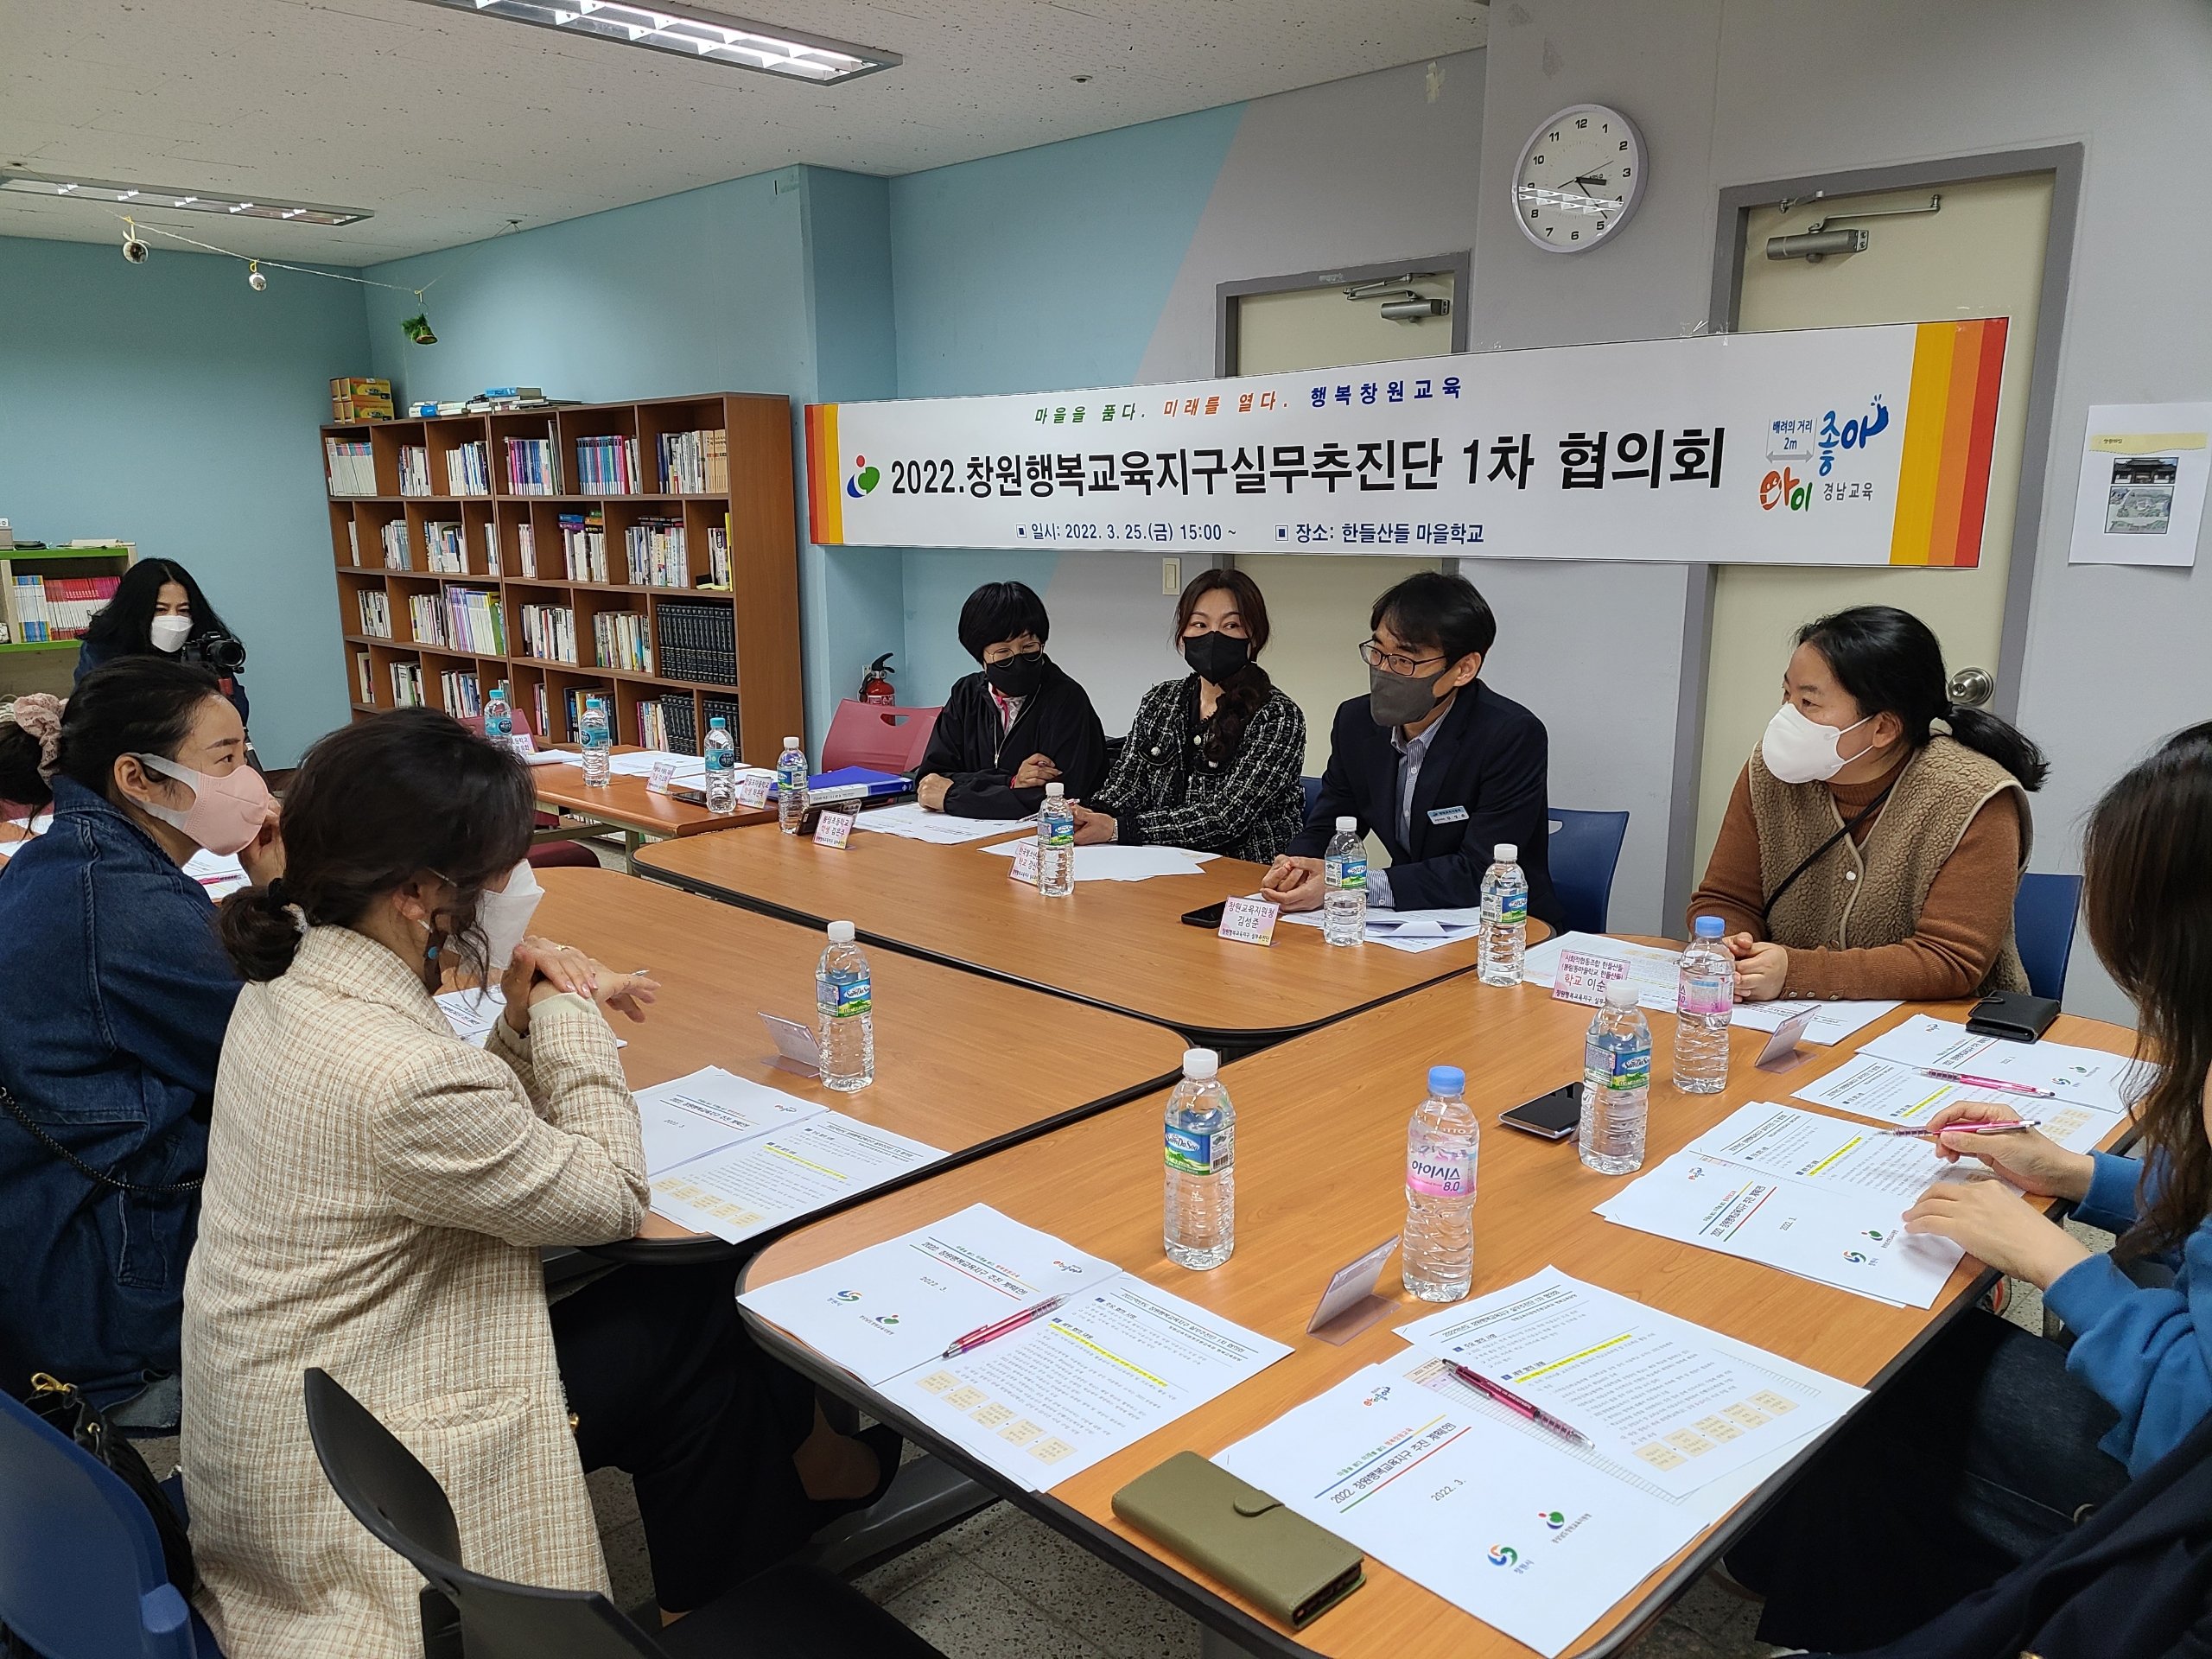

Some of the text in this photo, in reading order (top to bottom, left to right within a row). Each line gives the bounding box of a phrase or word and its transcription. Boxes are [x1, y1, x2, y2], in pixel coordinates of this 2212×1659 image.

[1575, 119, 1587, 129] 12
[1602, 124, 1608, 134] 1
[1549, 131, 1560, 142] 11
[1619, 141, 1628, 151] 2
[1533, 156, 1545, 165] 10
[1623, 168, 1631, 177] 3
[1531, 209, 1539, 219] 8
[1545, 227, 1554, 237] 7
[1597, 220, 1605, 231] 5
[1571, 231, 1580, 241] 6
[1034, 377, 1461, 425] 마을을 품다. 미래를 열다. 행복창원교육
[1772, 419, 1813, 435] 배려의 거리
[1783, 436, 1798, 450] 2m
[890, 428, 1726, 499] 2022.창원행복교육지구실무추진단 1차 협의회
[1823, 481, 1873, 501] 경남교육
[1031, 523, 1060, 541] 일시:
[1065, 523, 1103, 540] 2022.
[1107, 524, 1120, 539] 3.
[1125, 523, 1173, 543] 25.(금)
[1179, 524, 1222, 541] 15:00
[1295, 523, 1484, 545] 장소: 한들산들 마을학교
[1228, 901, 1275, 918] 창원교육지원청
[1237, 916, 1259, 929] 김성준
[1565, 954, 1624, 973] 사회적협동조합 한들산들
[1564, 973, 1606, 993] 학교 이순
[1555, 988, 1592, 1002] 창원행복교육지구
[1412, 1160, 1460, 1181] 아이시스
[1443, 1181, 1460, 1192] 8.0
[1330, 1422, 1457, 1504] 2022. 창원행복교육지구 추진 계획(안)
[1431, 1485, 1457, 1502] 2022.
